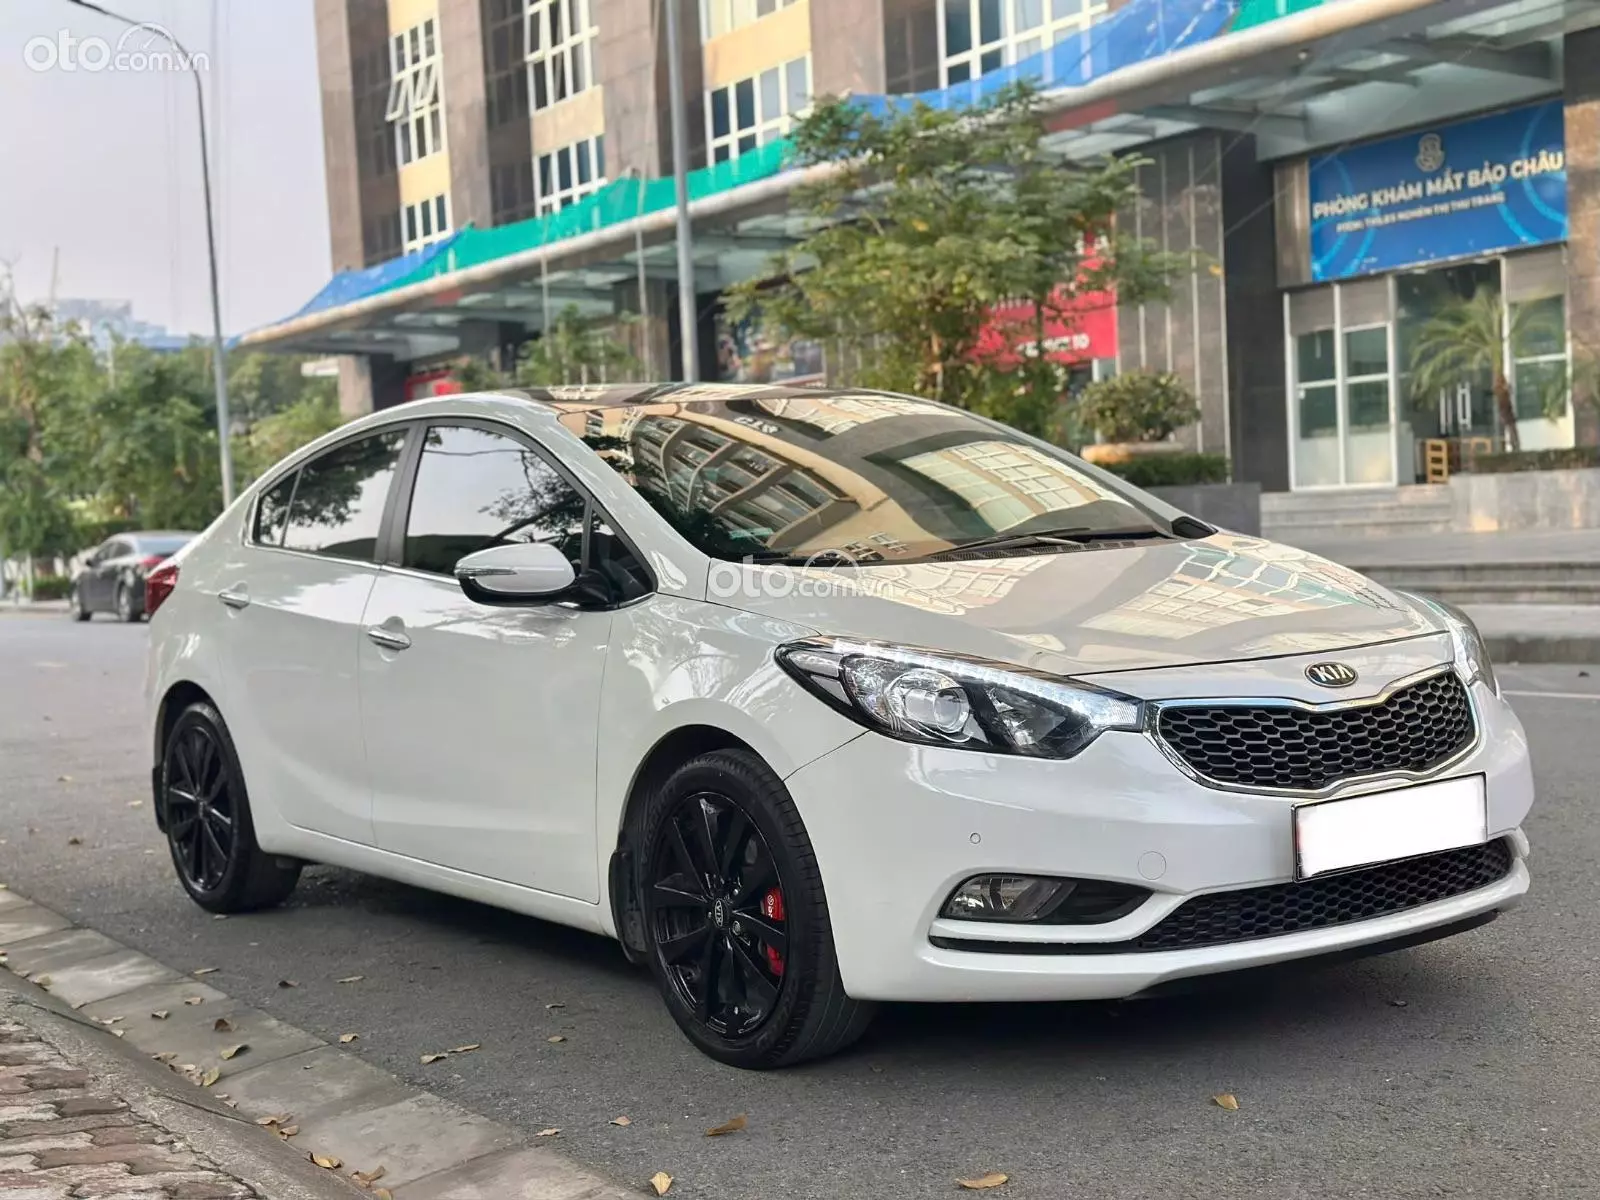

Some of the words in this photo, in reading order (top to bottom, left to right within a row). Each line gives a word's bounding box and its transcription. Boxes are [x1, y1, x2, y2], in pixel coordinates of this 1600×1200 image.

[1312, 193, 1369, 219] PHÒNG
[1371, 180, 1423, 208] KHÁM
[1426, 167, 1464, 196] MẮT
[1467, 160, 1507, 188] BẢO
[1510, 149, 1564, 179] CHÂU
[1312, 664, 1354, 682] KIA
